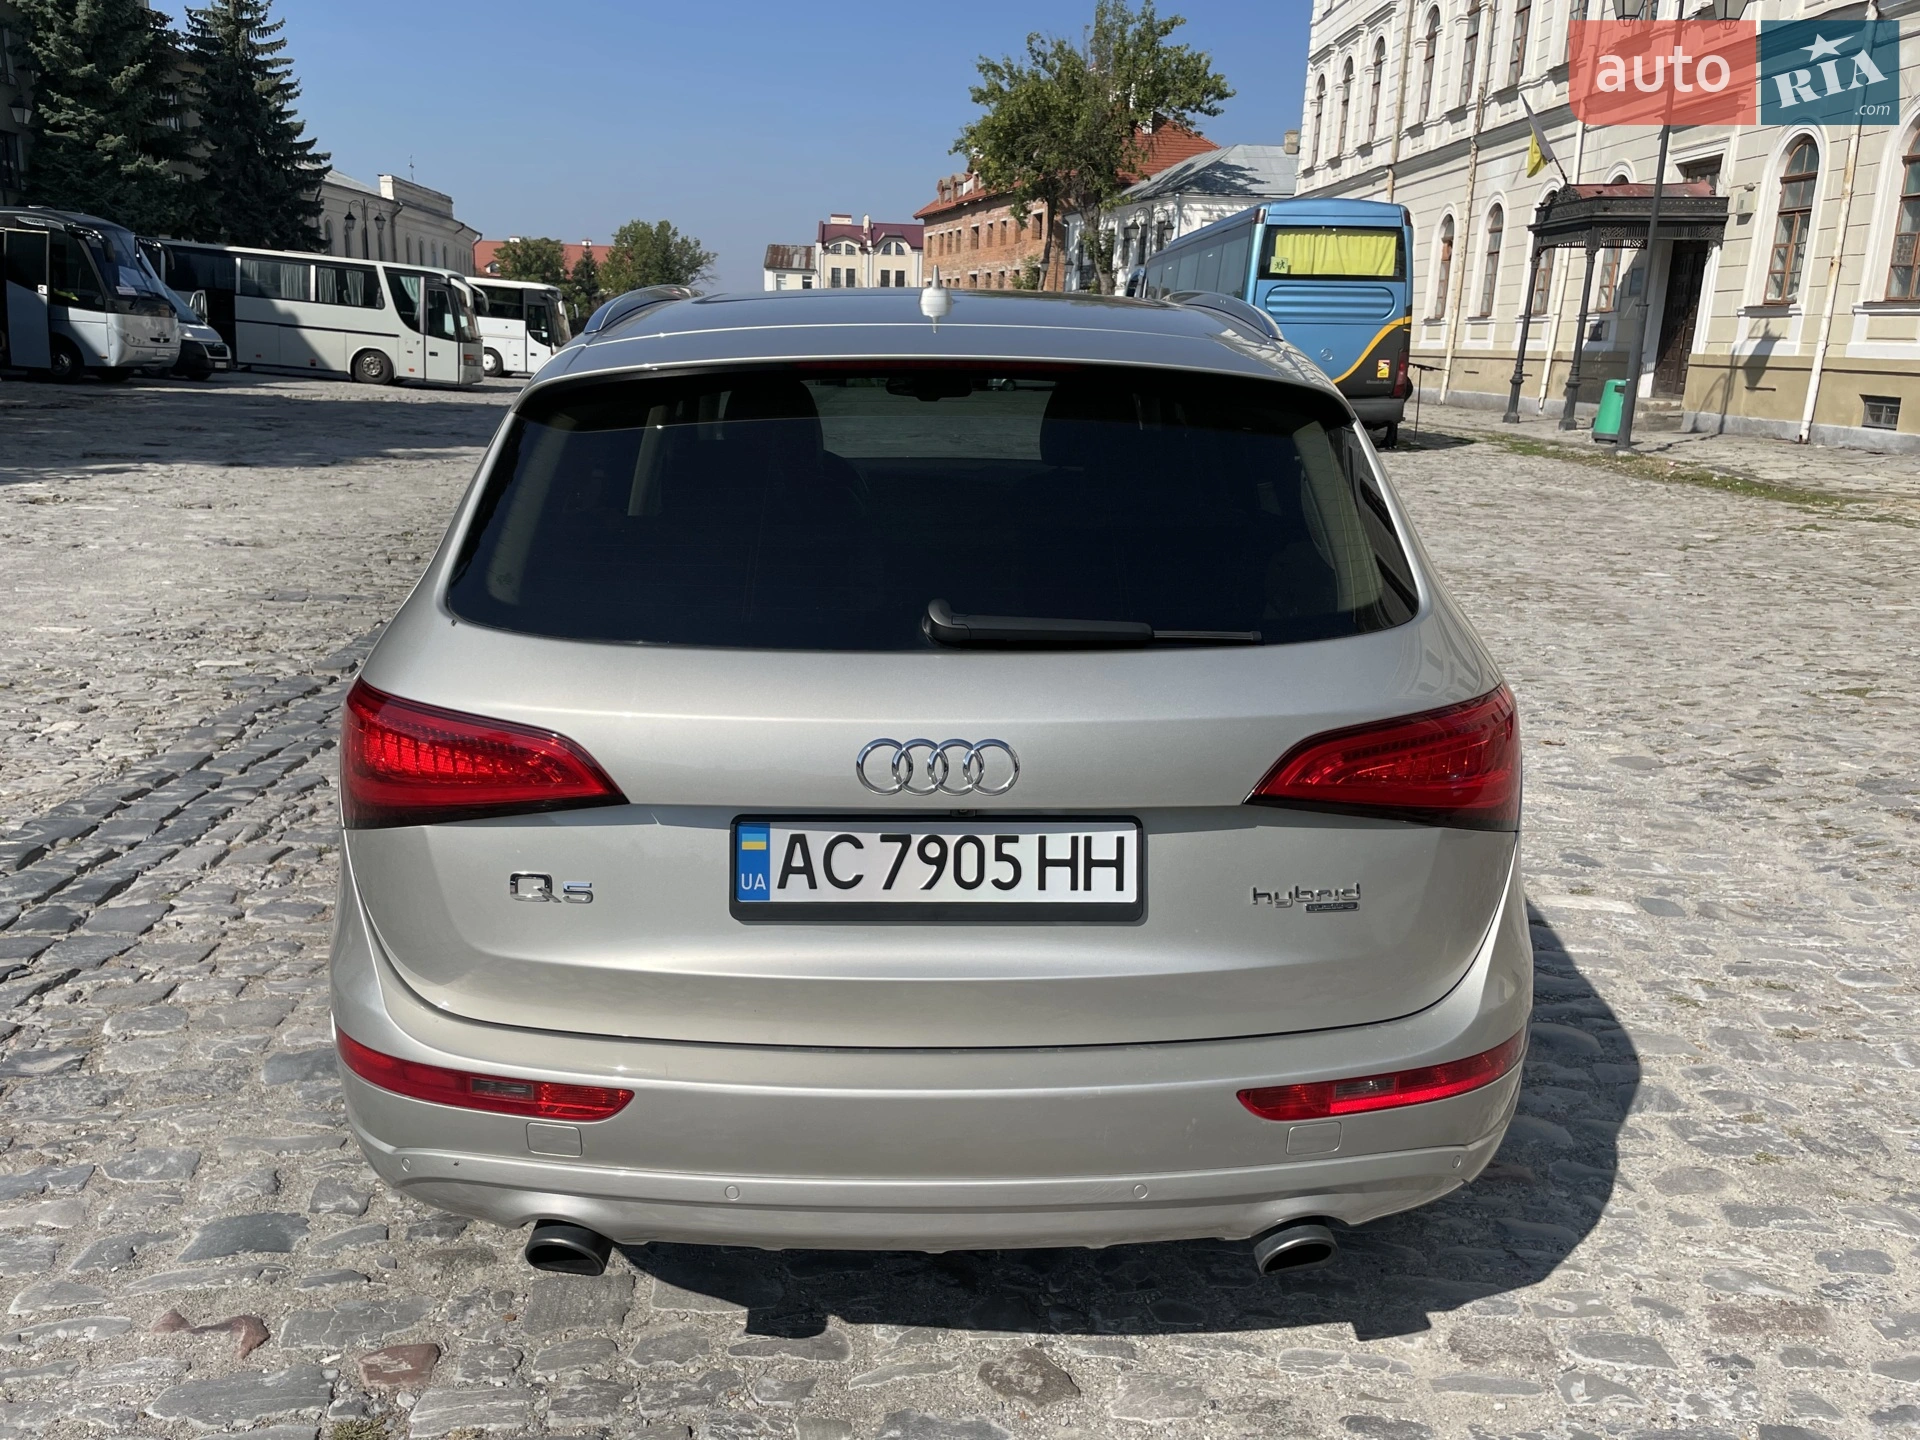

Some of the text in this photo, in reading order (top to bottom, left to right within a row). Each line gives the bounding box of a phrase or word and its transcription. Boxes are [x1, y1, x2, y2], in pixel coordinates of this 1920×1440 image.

[776, 833, 1125, 892] AC 7905 HH
[510, 871, 594, 904] Q5
[741, 873, 767, 891] UA
[1252, 882, 1360, 908] hybrid
